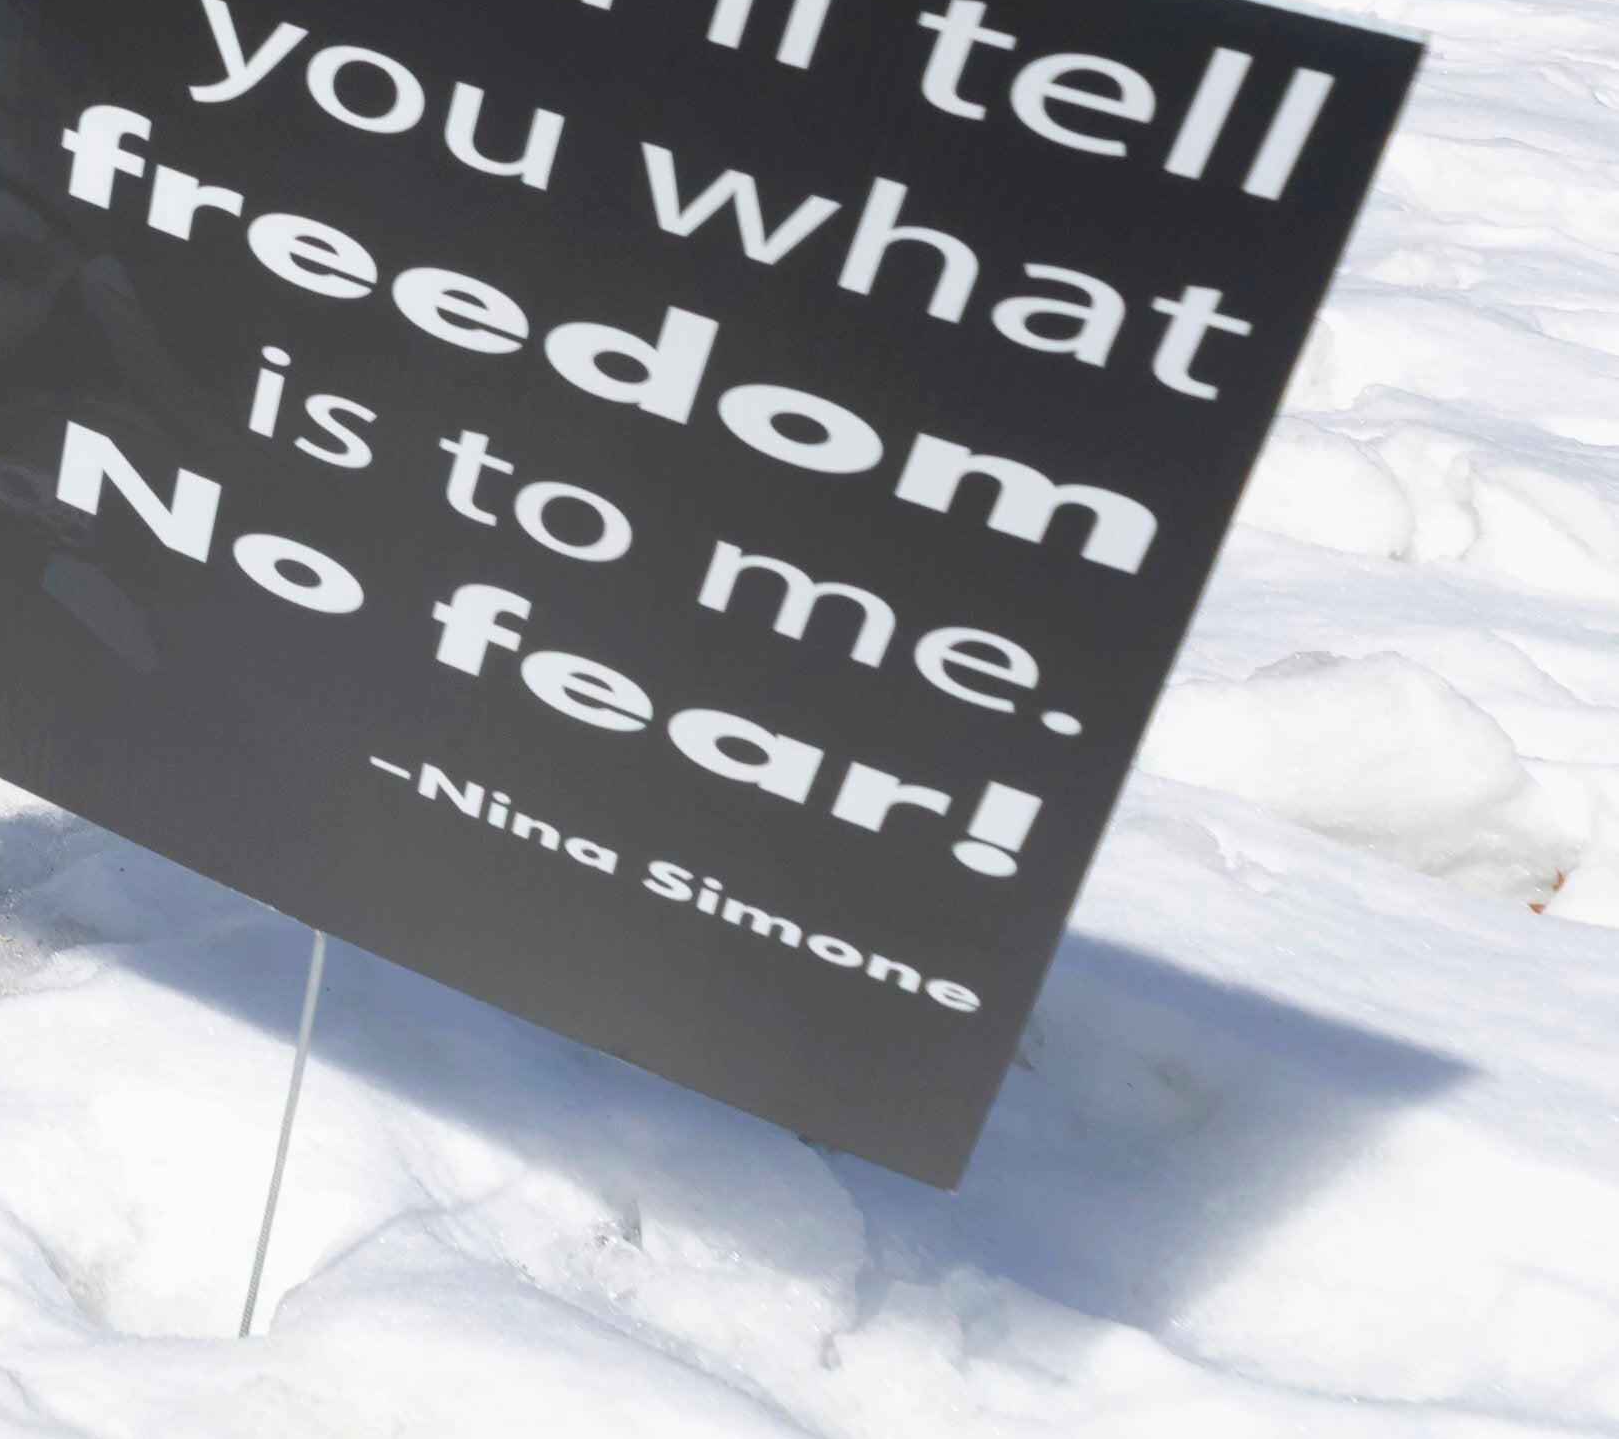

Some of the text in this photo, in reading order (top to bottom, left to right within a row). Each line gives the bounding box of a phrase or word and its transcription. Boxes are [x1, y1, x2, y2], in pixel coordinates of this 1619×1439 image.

[59, 102, 1160, 575] freedom
[639, 139, 1255, 402] what
[54, 418, 1044, 879] No fear!
[245, 343, 1085, 737] is to me.
[641, 856, 983, 1014] Simone
